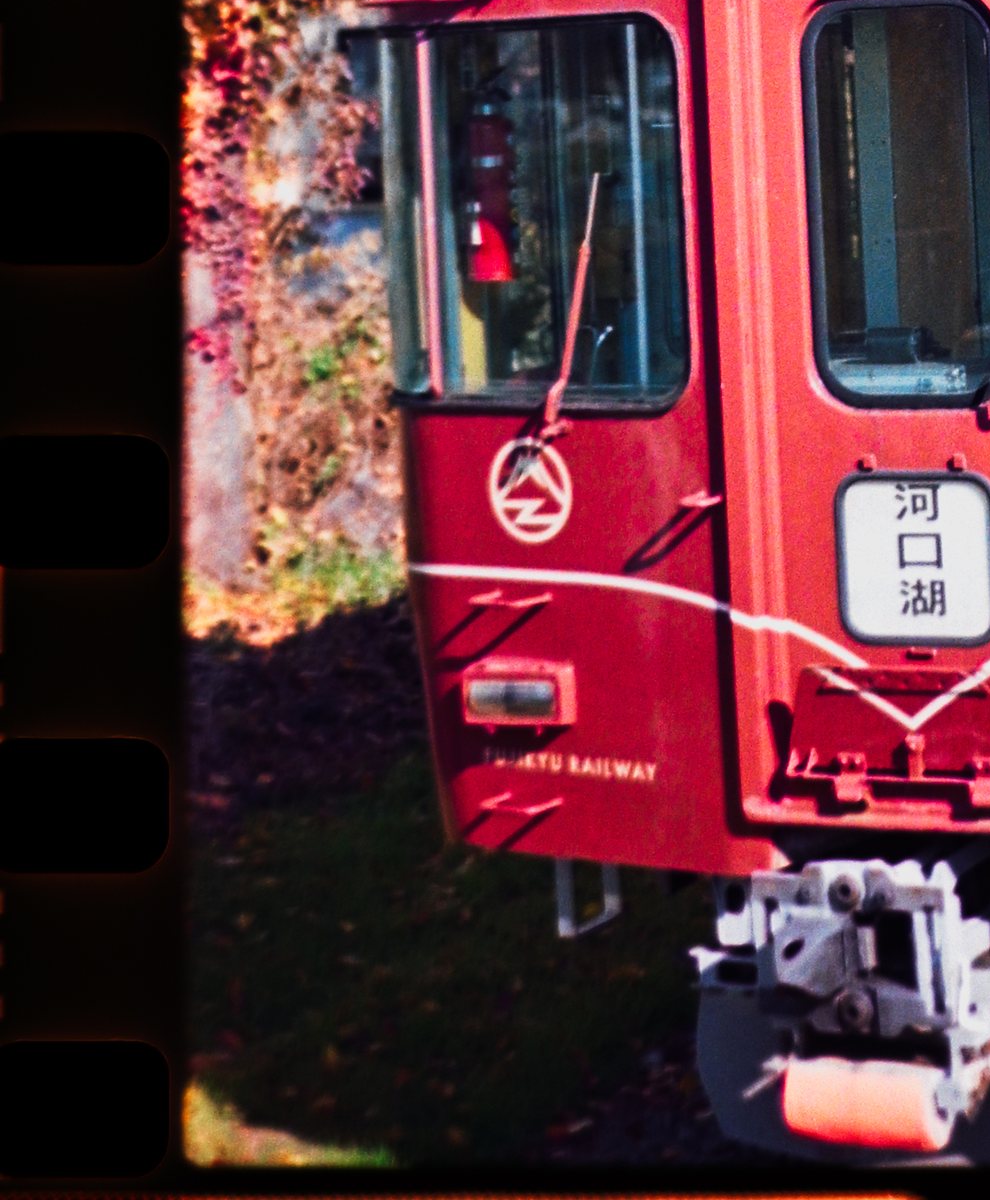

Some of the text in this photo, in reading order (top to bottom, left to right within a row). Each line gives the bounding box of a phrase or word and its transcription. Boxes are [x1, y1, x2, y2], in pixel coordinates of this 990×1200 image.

[895, 483, 947, 616] 河口湖
[569, 754, 657, 782] RAILWAY
